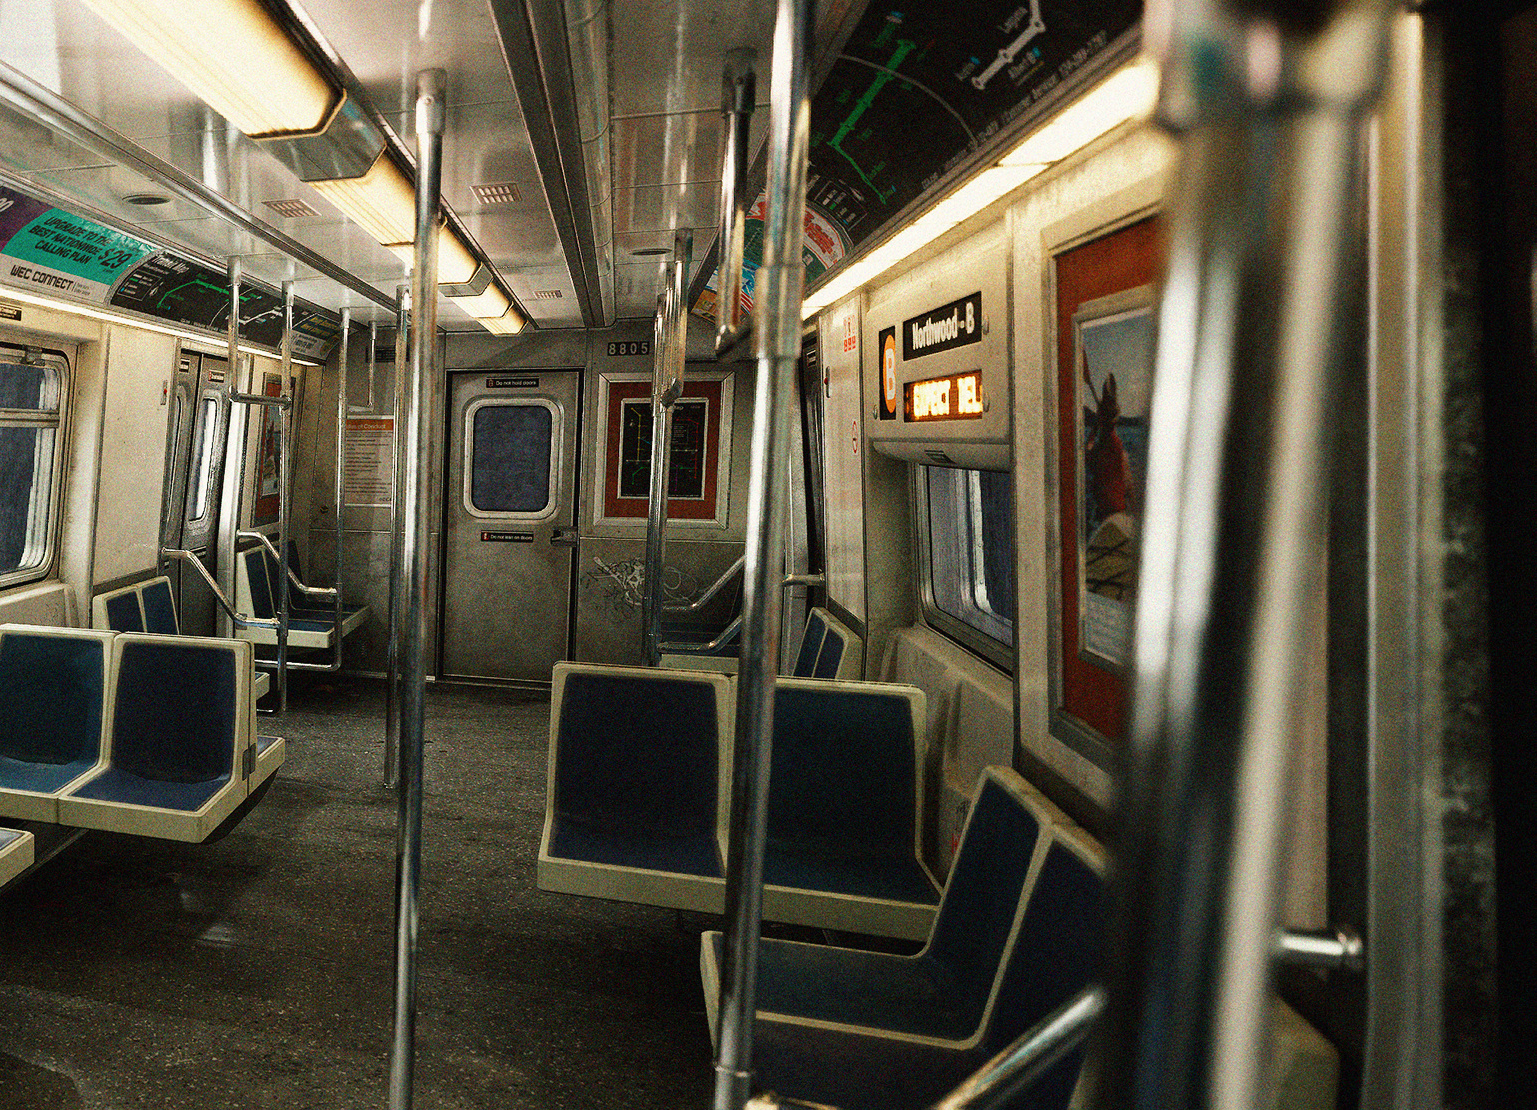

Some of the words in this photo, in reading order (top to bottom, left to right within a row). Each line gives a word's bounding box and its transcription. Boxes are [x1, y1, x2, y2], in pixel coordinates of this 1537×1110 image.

[28, 224, 57, 239] BEST
[51, 233, 103, 256] NATIONWIDE
[43, 216, 88, 237] UPGRADE
[83, 231, 99, 240] TO
[34, 240, 72, 258] CALLING
[68, 251, 93, 265] PLAN
[98, 247, 133, 269] $29
[9, 264, 33, 280] WEC
[32, 270, 74, 291] CONNECT
[912, 307, 958, 351] Northwood
[608, 342, 649, 355] 8805
[885, 347, 896, 401] B
